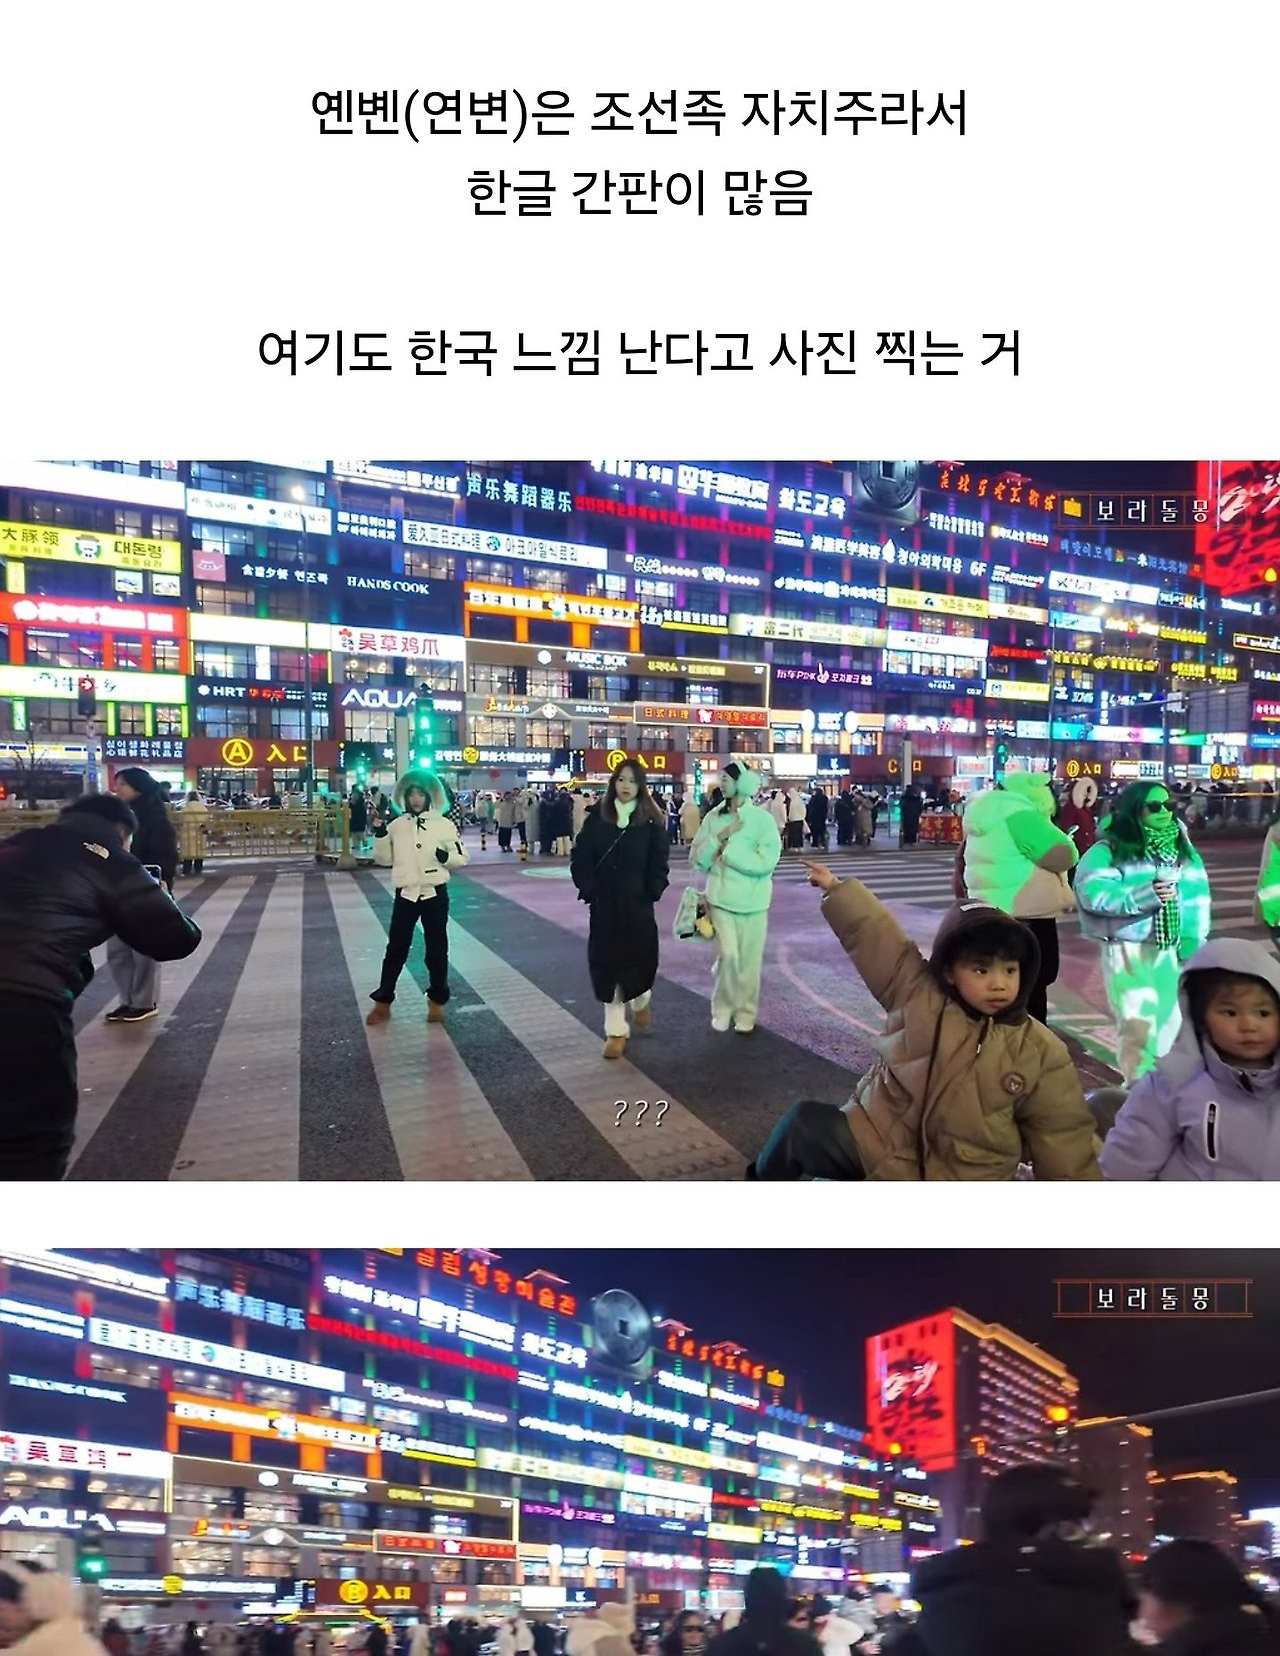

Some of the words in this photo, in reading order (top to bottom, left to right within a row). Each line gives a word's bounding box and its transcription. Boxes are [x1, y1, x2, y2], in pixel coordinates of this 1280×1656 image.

[466, 475, 573, 513] 声乐舞蹈器乐
[358, 631, 440, 657] 吴草鸡爪
[212, 685, 247, 699] HRT
[372, 1583, 412, 1601] 入口
